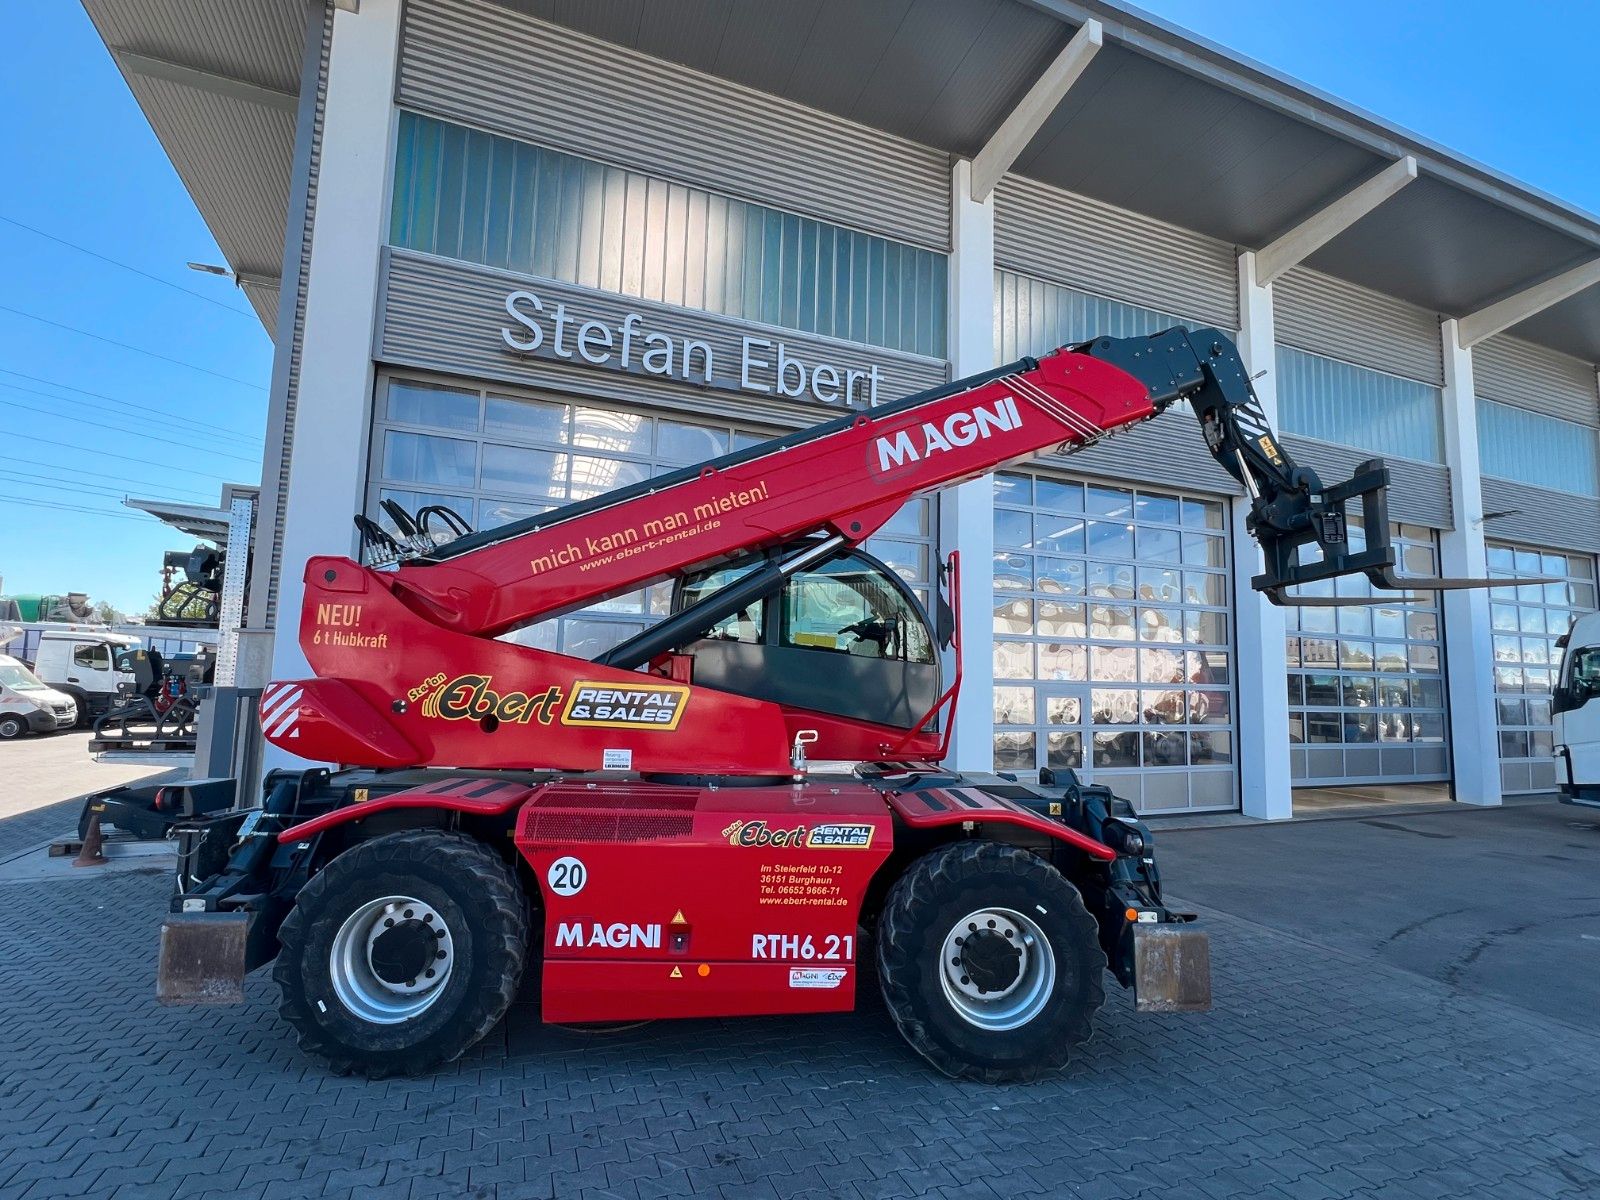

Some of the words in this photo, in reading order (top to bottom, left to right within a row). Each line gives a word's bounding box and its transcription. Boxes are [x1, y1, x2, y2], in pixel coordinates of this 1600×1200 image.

[501, 291, 713, 382] Stefan
[741, 336, 885, 408] Ebert
[876, 396, 1023, 472] MAGNI
[530, 543, 582, 574] mich
[586, 536, 639, 556] kann
[643, 511, 689, 538] man
[694, 480, 769, 521] mieten!
[579, 519, 721, 572] www.ebert-rental.de
[317, 603, 362, 627] NEU!
[313, 630, 321, 645] 6
[324, 631, 330, 645] t
[333, 631, 388, 648] Hubkraft
[408, 672, 447, 702] Stefan
[438, 674, 564, 725] Ebert
[577, 689, 677, 707] RENTAL
[571, 705, 593, 719] &
[594, 706, 673, 722] SALES
[739, 820, 807, 848] Ebert
[811, 836, 824, 844] &
[825, 836, 867, 845] SALES
[813, 827, 868, 836] RENTAL
[553, 864, 583, 889] 20
[760, 864, 772, 873] Im
[774, 864, 816, 873] Steierfeld
[819, 865, 842, 874] 10-12
[760, 875, 786, 883] 36151
[789, 876, 832, 885] Burghaun
[760, 897, 848, 906] www.ebert-rental.de
[761, 885, 775, 894] Tel.
[778, 886, 804, 894] 06652
[806, 887, 840, 895] 9666-71
[555, 923, 661, 948] MAGNI
[752, 934, 853, 960] RTH6.21
